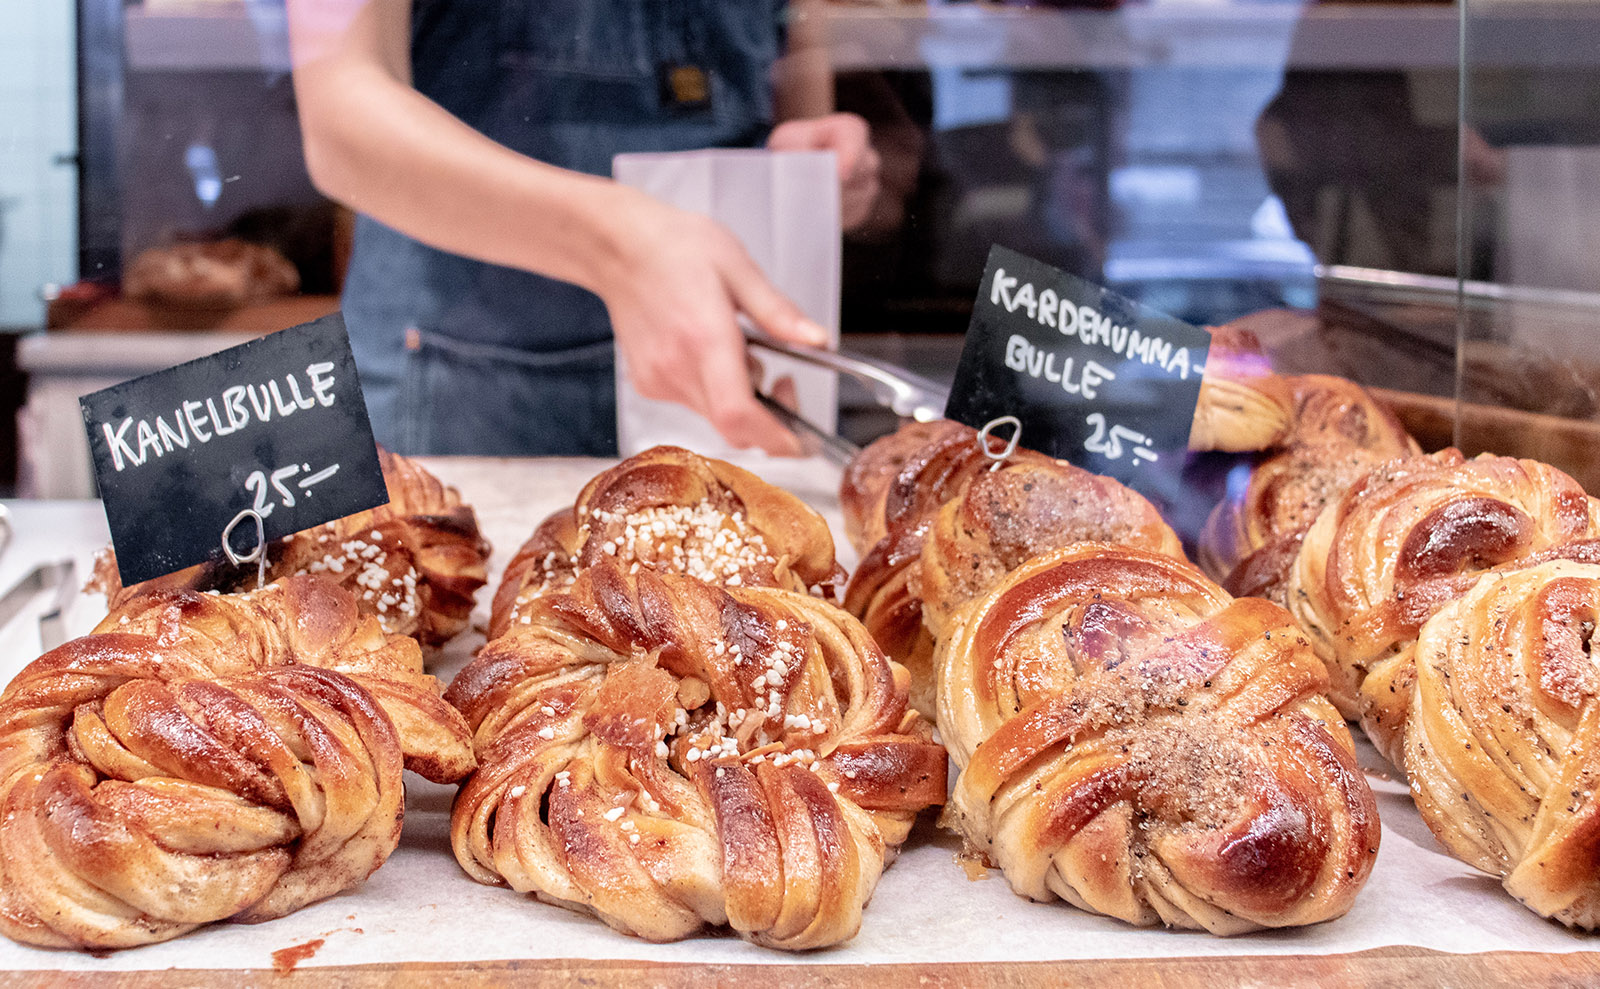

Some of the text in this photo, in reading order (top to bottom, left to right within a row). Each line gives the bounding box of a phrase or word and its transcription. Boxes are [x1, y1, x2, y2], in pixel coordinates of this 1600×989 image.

[990, 268, 1206, 380] KARDEMUMMA-
[1004, 334, 1116, 400] BULLE
[102, 361, 336, 472] KANELBULLE
